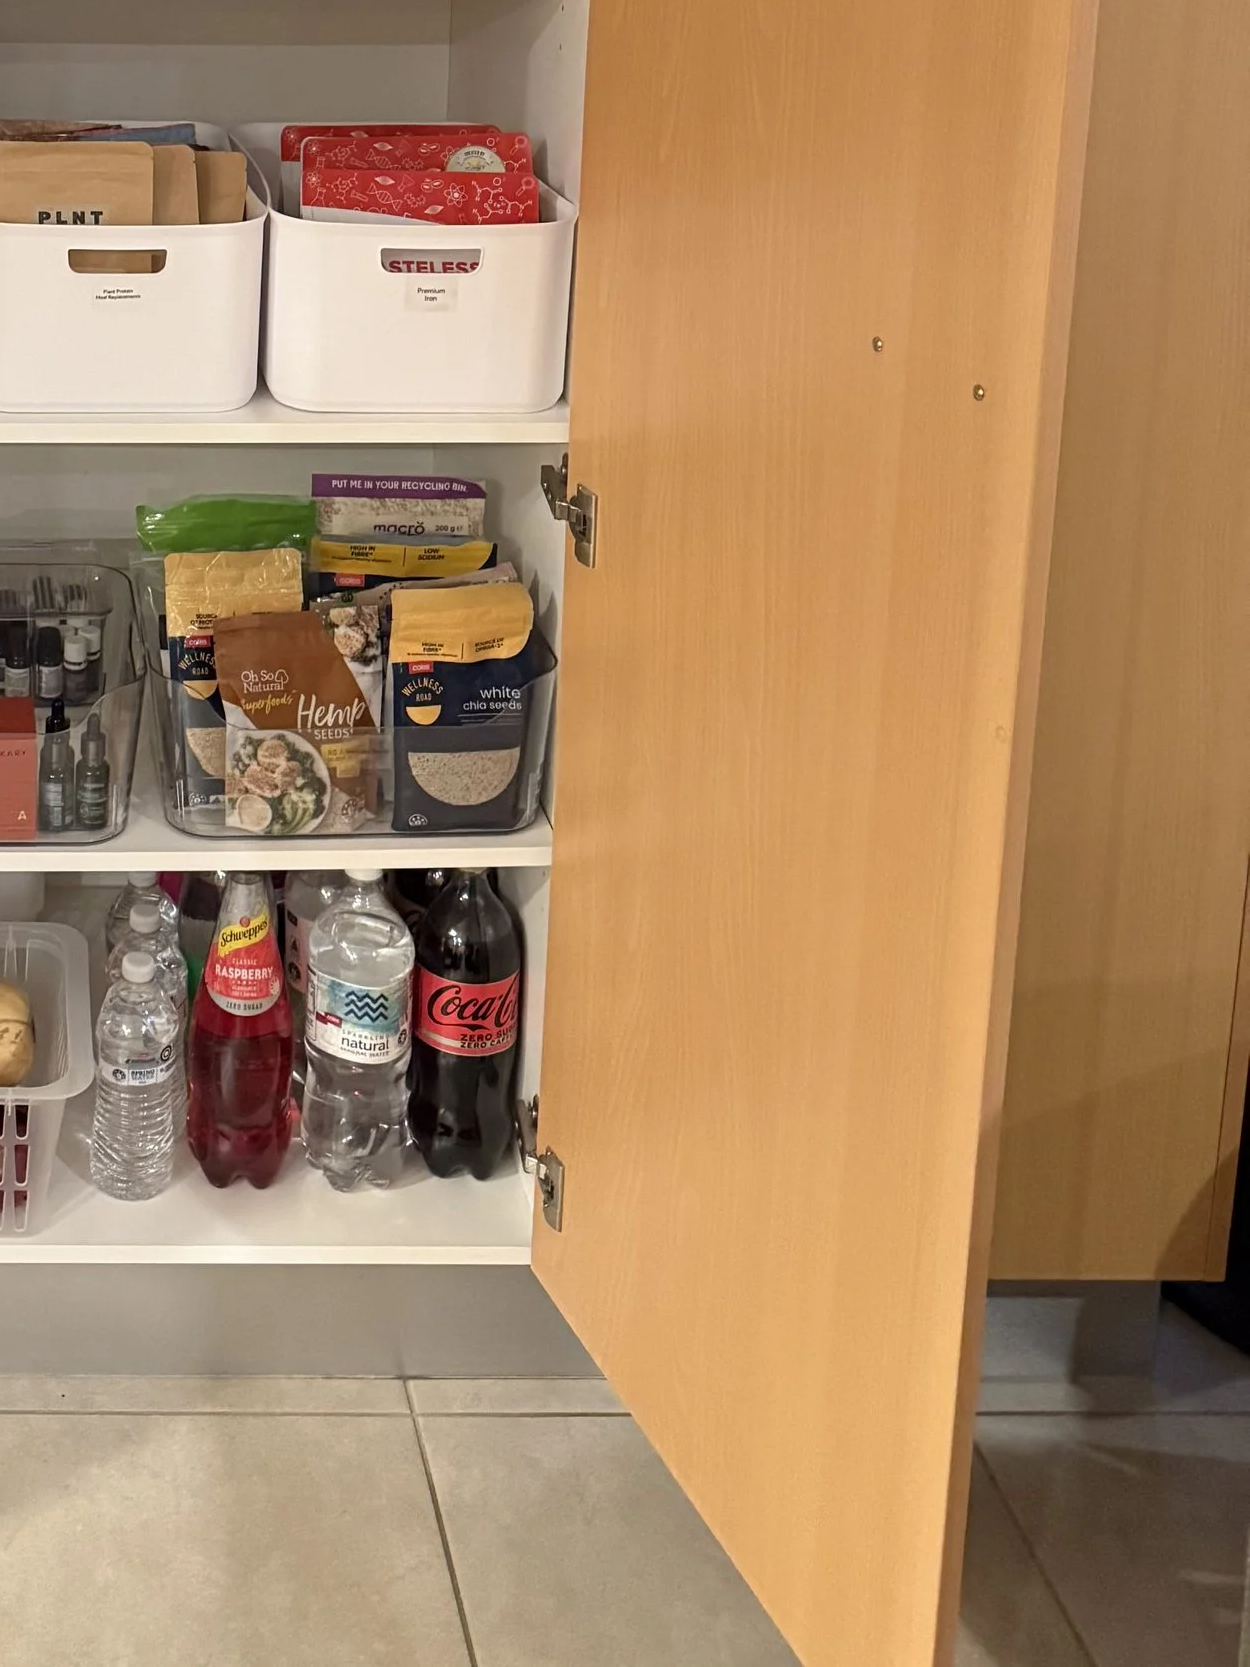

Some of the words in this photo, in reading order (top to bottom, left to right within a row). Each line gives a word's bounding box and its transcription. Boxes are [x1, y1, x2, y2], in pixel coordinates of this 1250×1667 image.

[38, 211, 103, 225] PLNT
[332, 480, 347, 488] PUT
[350, 480, 361, 489] ME
[364, 481, 373, 489] IN
[376, 481, 399, 489] YOUR
[402, 481, 450, 491] RECYCLING
[452, 483, 468, 492] BIN.
[435, 524, 448, 532] 200
[192, 667, 209, 675] ROAD
[241, 670, 258, 682] Oh
[260, 670, 274, 681] So
[243, 682, 284, 694] Natural
[401, 678, 443, 697] WELLNESS
[480, 686, 521, 699] white
[416, 693, 432, 702] ROAD
[463, 701, 486, 711] chia
[490, 700, 522, 710] seeds
[297, 694, 366, 733] Hemp
[314, 729, 350, 740] SEEDS
[17, 810, 27, 820] A
[221, 919, 268, 947] Schweppes
[215, 963, 274, 980] RASPBERRY
[226, 1001, 241, 1010] ZERO
[244, 1003, 263, 1011] SUGAR
[460, 1033, 492, 1041] ZERO
[341, 1037, 389, 1051] natural
[460, 1041, 487, 1049] ZERO
[369, 1050, 389, 1058] WATER
